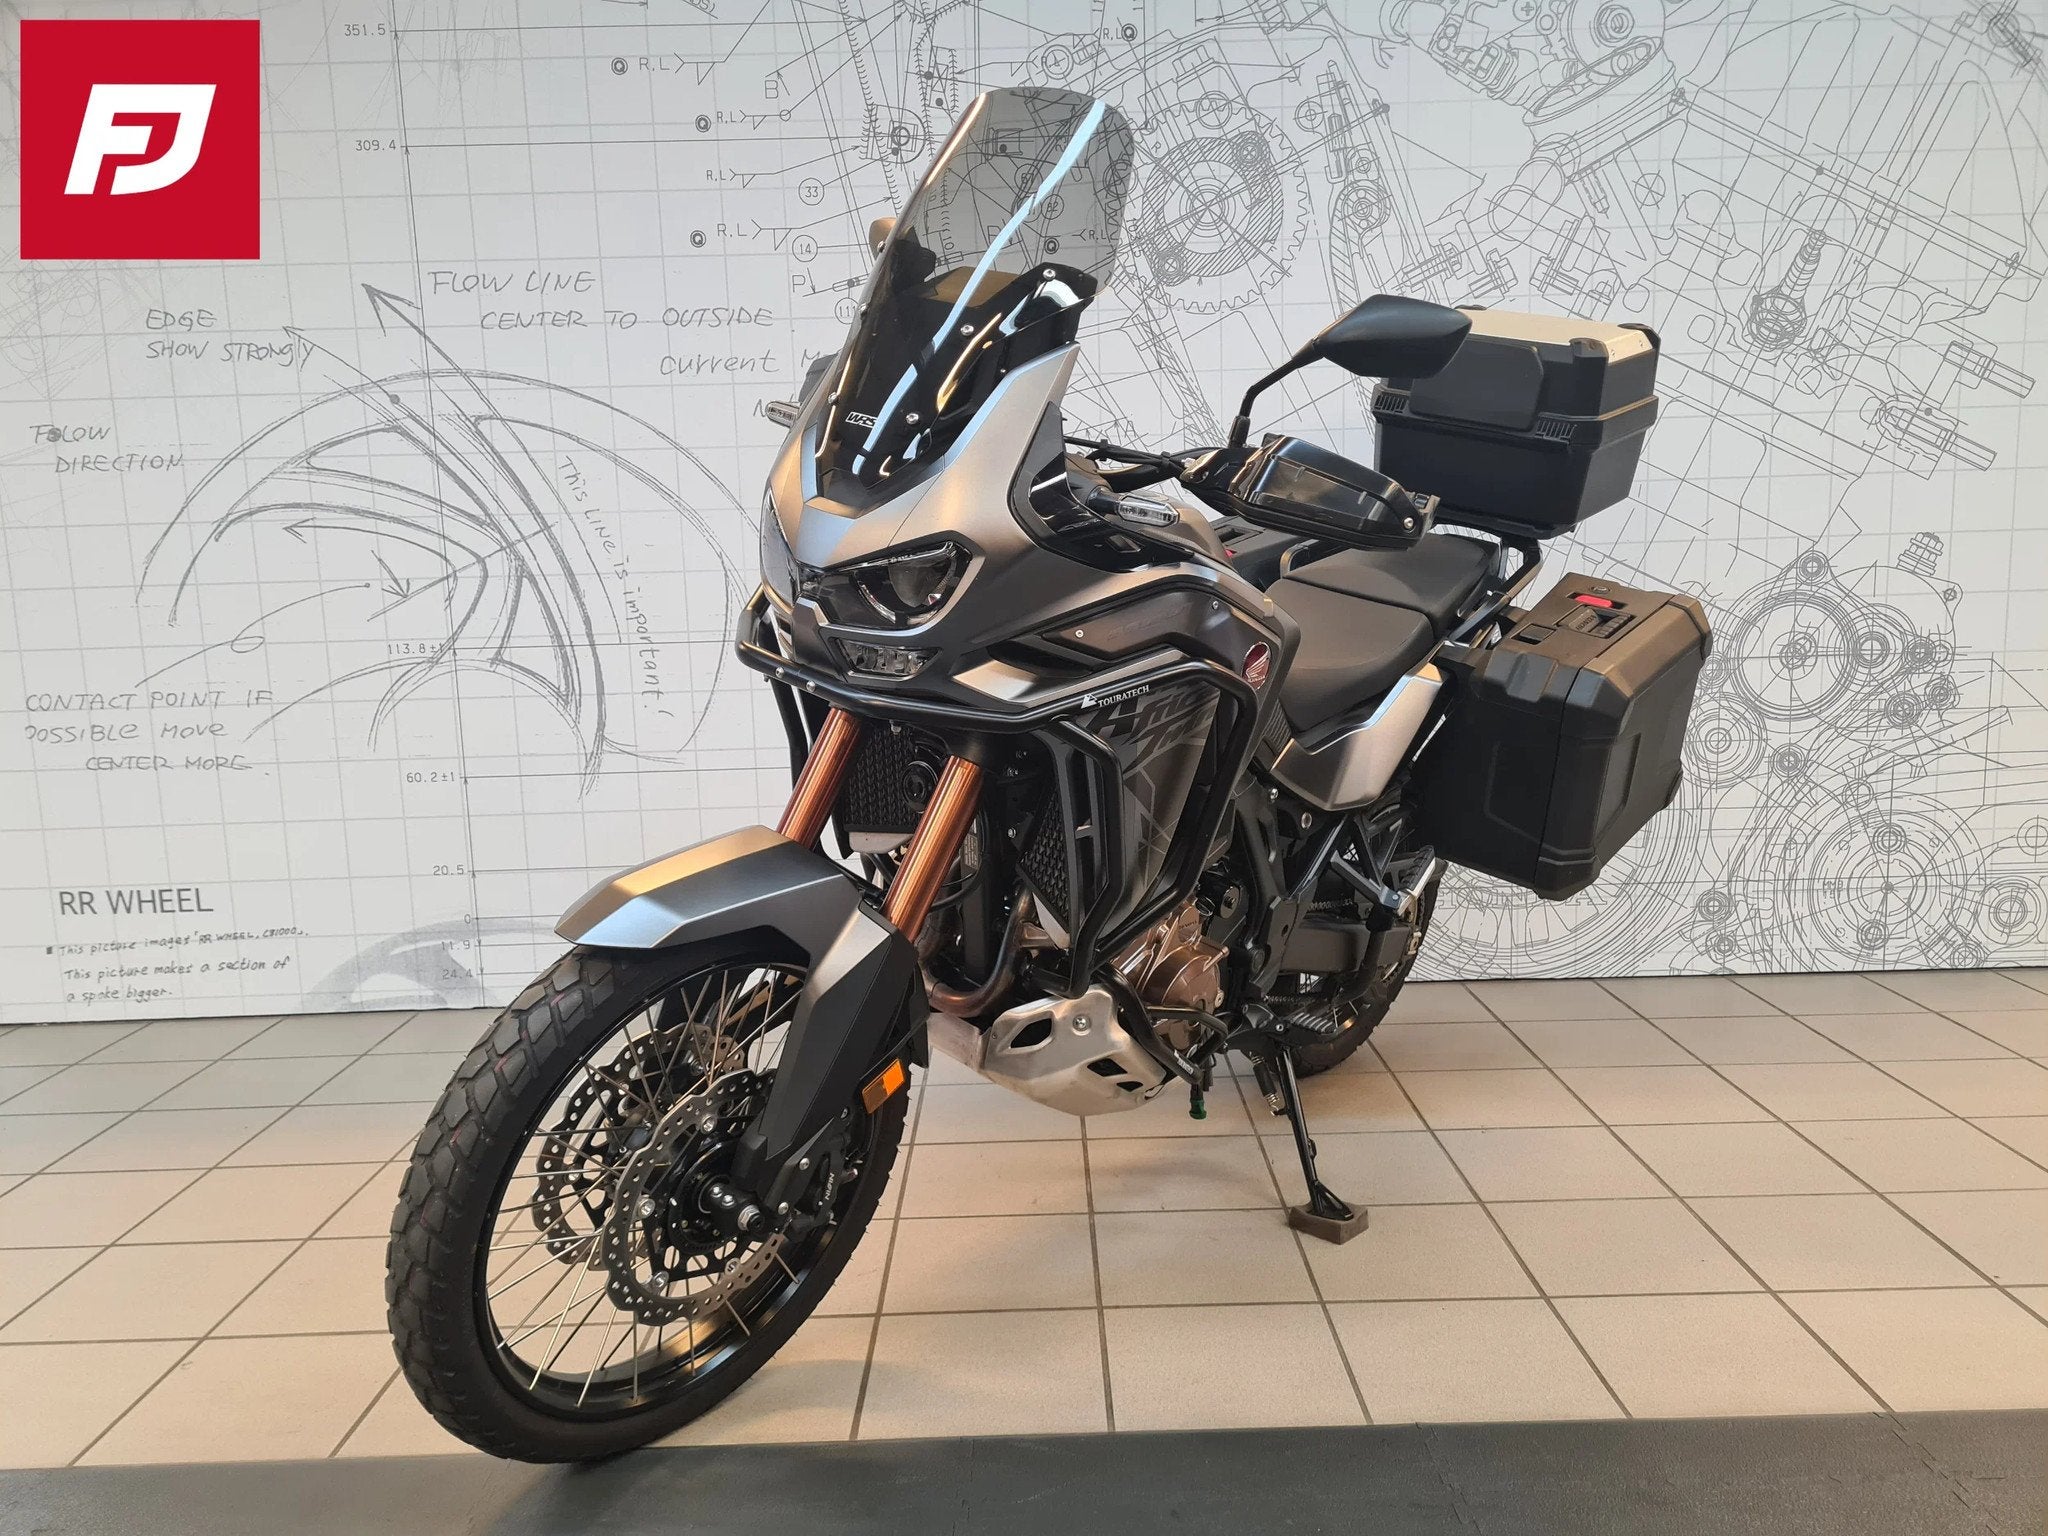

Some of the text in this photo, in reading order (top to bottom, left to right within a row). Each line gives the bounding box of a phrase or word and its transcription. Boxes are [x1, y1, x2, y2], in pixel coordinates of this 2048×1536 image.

[344, 23, 386, 36] 351.5
[355, 139, 397, 151] 309.4
[804, 186, 819, 198] 33
[799, 242, 812, 255] 14
[427, 269, 597, 295] FLOW LINE
[145, 308, 218, 332] EDGE
[480, 306, 775, 330] CENTER TO OUTSIDE
[145, 339, 210, 360] SHOW
[55, 453, 184, 475] DIRECTION
[25, 689, 274, 712] CONTACT POINT IF
[1097, 685, 1150, 708] TOURATECH
[85, 755, 174, 771] CENTER
[433, 864, 465, 876] 20.5
[58, 887, 214, 916] RR WHEEL
[464, 913, 471, 924] 0
[59, 944, 84, 956] This
[441, 939, 471, 951] 11.9
[64, 955, 290, 984] This picture makes a section of
[441, 968, 473, 980] 24.4
[66, 984, 173, 1006] a spoke bigger.
